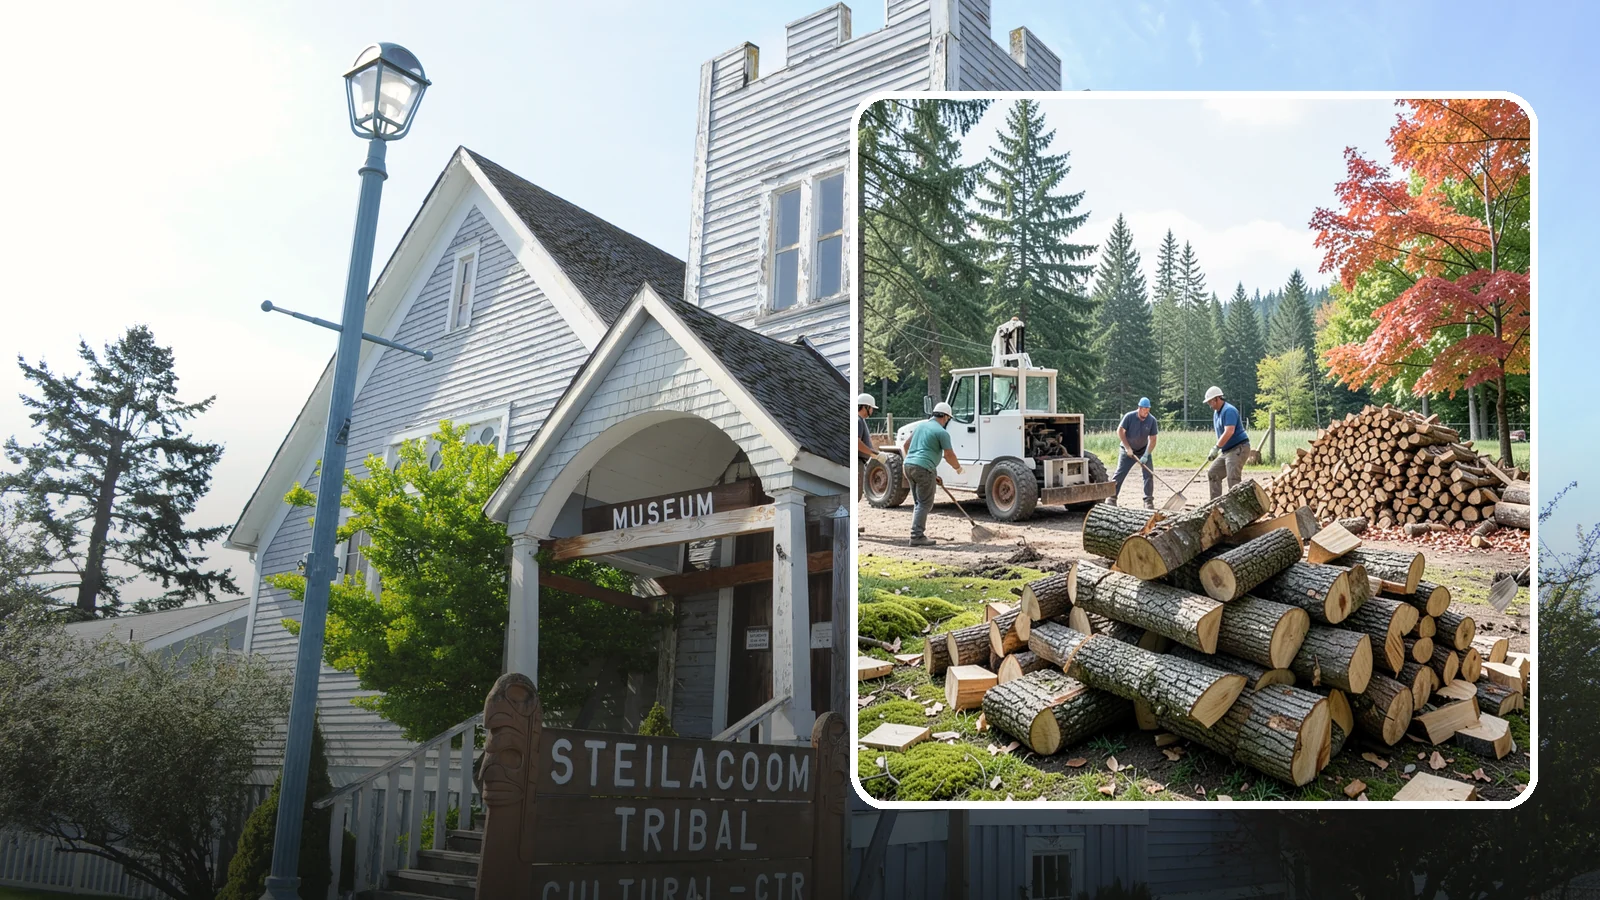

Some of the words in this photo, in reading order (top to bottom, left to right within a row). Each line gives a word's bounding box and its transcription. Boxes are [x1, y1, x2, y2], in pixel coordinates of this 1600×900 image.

[613, 491, 713, 531] MUSEUM
[550, 738, 810, 793] STEILACOOM
[614, 806, 758, 853] TRIBAL
